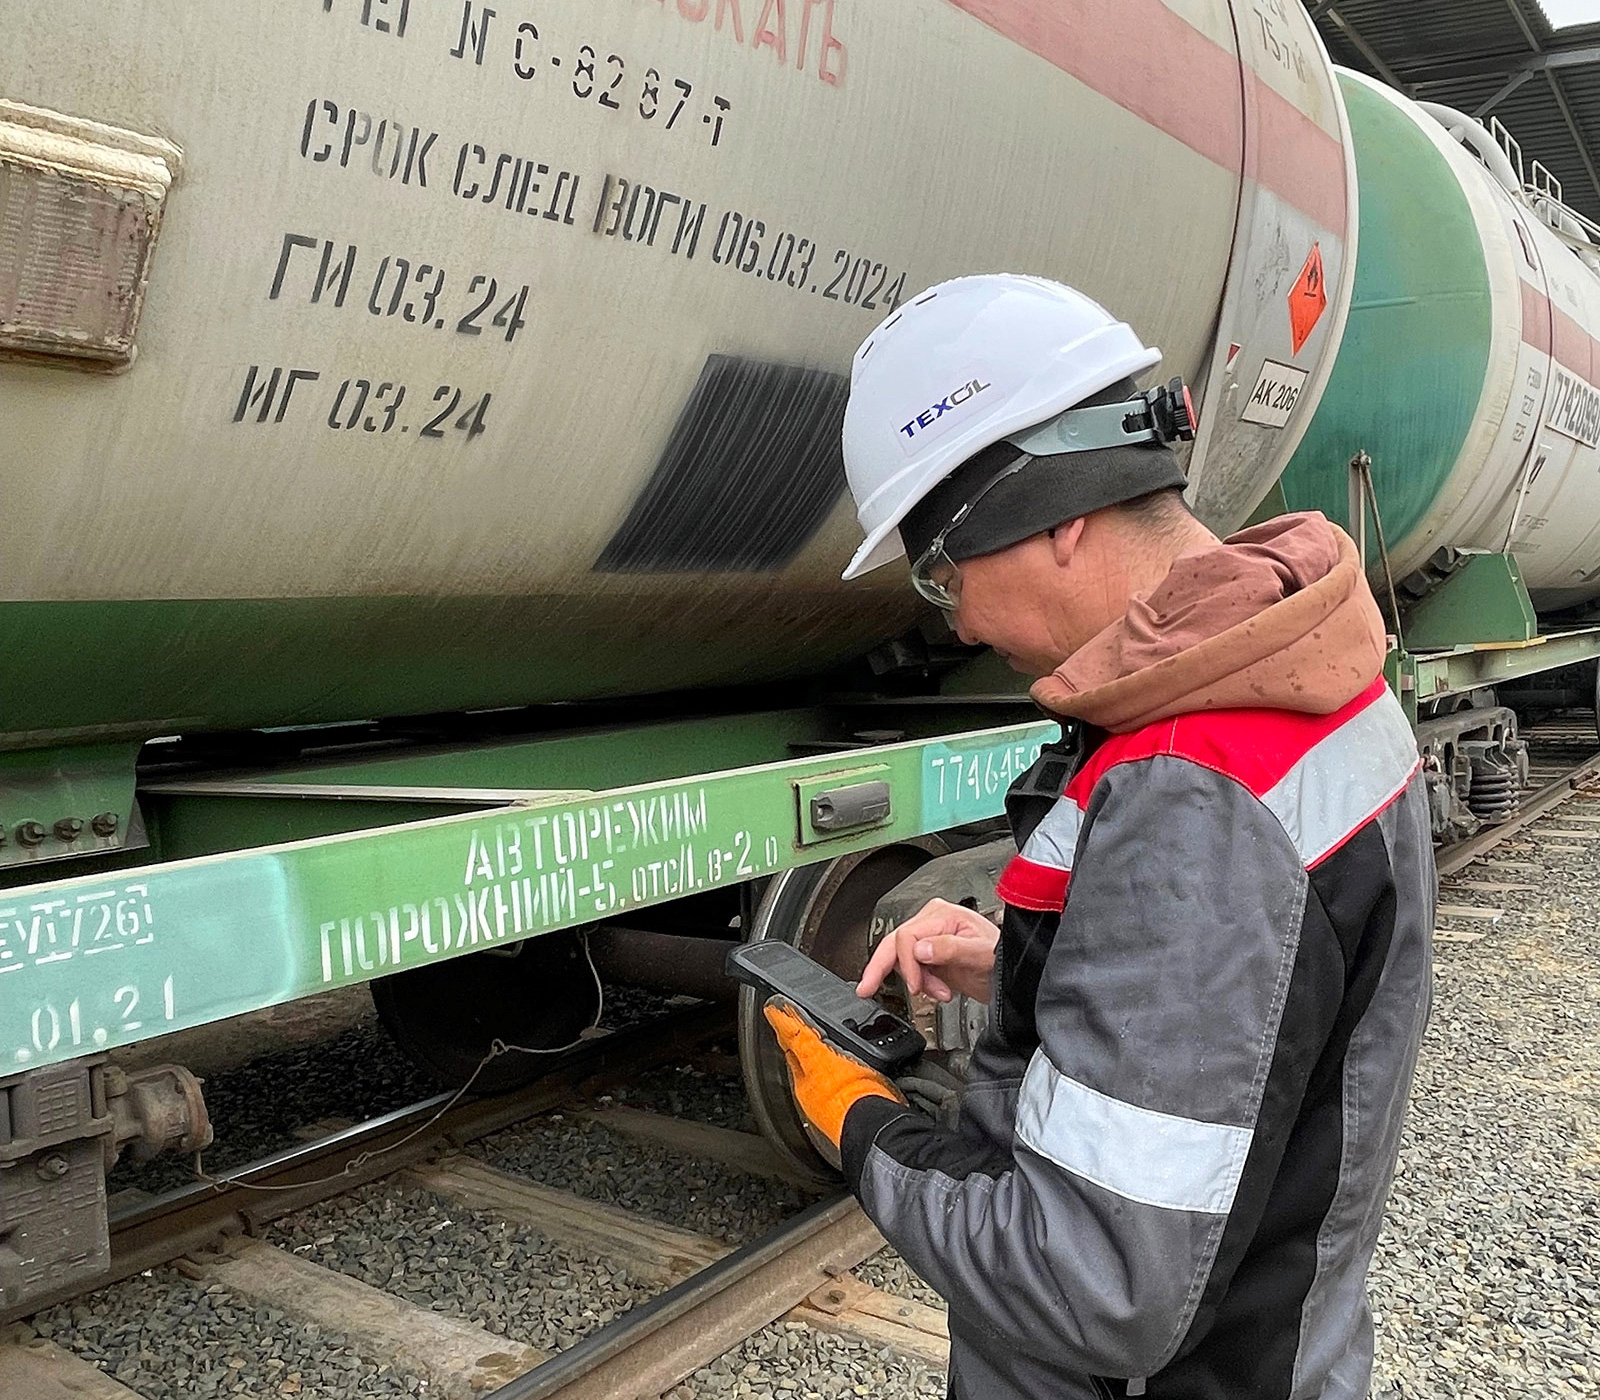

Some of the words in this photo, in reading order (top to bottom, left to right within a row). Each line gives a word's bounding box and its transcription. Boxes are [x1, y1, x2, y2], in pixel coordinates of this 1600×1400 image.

[301, 98, 438, 187] СРОК
[453, 143, 580, 225] СЛЕД
[712, 210, 907, 314] 06.03.2024
[269, 233, 357, 308] ГИ
[368, 255, 530, 343] 03.24
[232, 365, 321, 424] ИГ
[327, 378, 492, 442] 03.24
[1271, 384, 1299, 412] 206
[464, 788, 708, 886] АВТОРЕЖИМ
